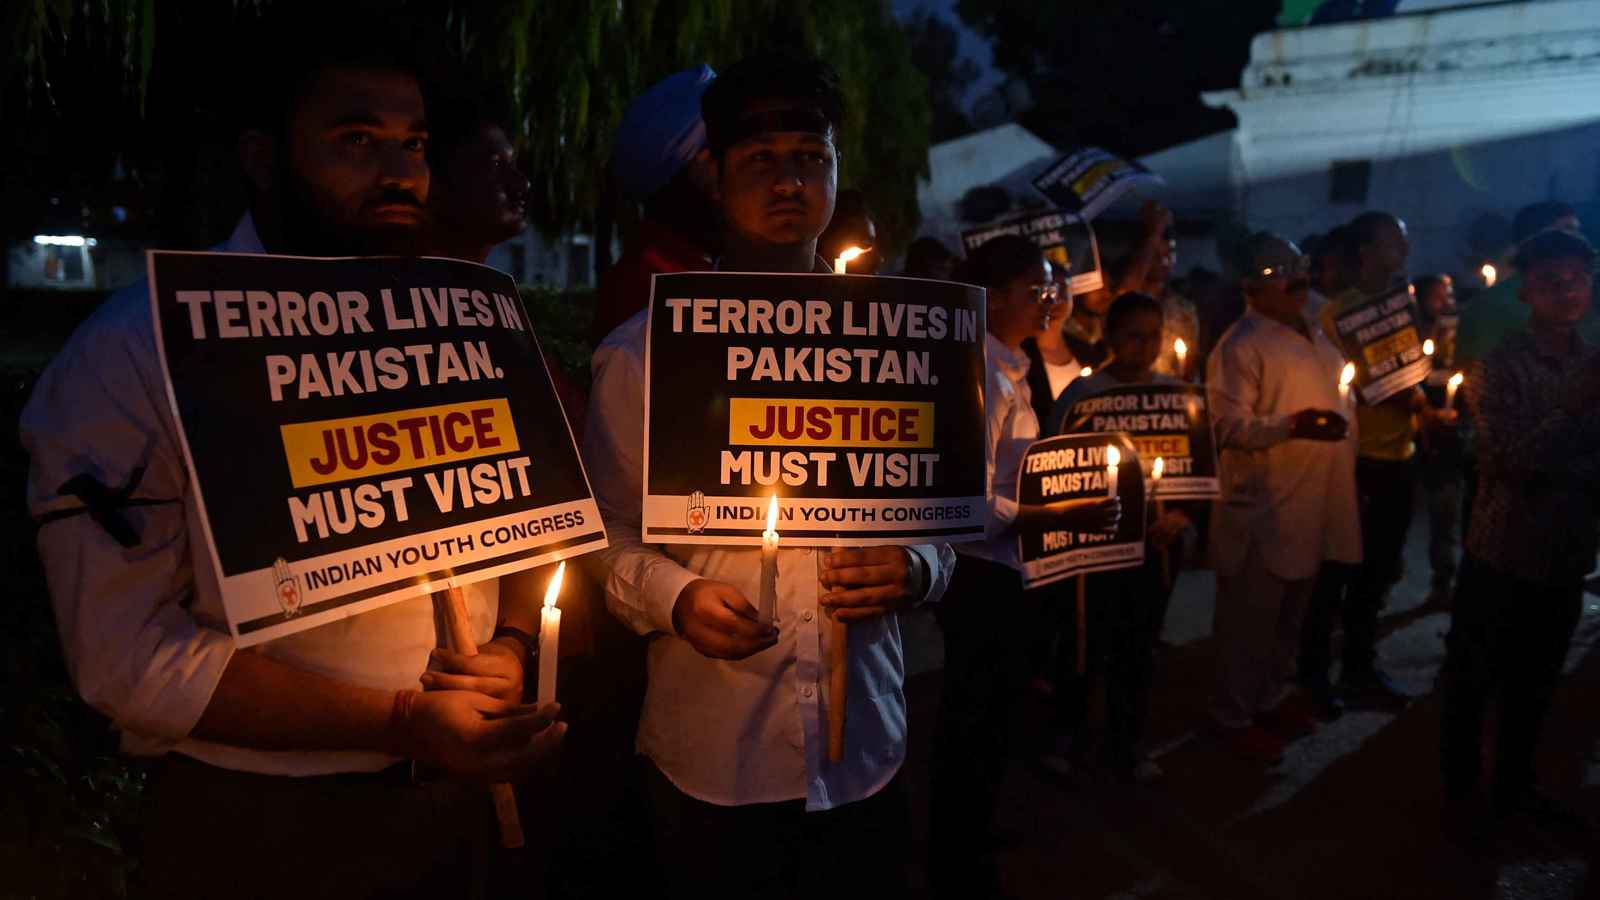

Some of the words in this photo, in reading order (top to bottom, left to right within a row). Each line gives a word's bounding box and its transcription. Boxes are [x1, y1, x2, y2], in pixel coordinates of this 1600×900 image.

[176, 288, 376, 341] TERROR
[383, 287, 493, 332] LIVES
[494, 294, 525, 332] IN
[665, 297, 832, 336] TERROR
[842, 300, 948, 341] LIVES
[953, 307, 977, 344] IN
[264, 340, 505, 402] PAKISTAN.
[726, 346, 940, 386] PAKISTAN.
[309, 407, 501, 475] JUSTICE
[749, 405, 920, 442] JUSTICE
[720, 450, 837, 487] MUST
[846, 451, 941, 488] VISIT
[1026, 447, 1075, 475] TERROR
[287, 476, 414, 544] MUST
[423, 455, 533, 514] VISIT
[799, 507, 877, 522] YOUTH
[881, 504, 971, 523] CONGRESS
[305, 555, 382, 592] INDIAN
[386, 533, 475, 569] YOUTH
[480, 510, 585, 547] CONGRESS
